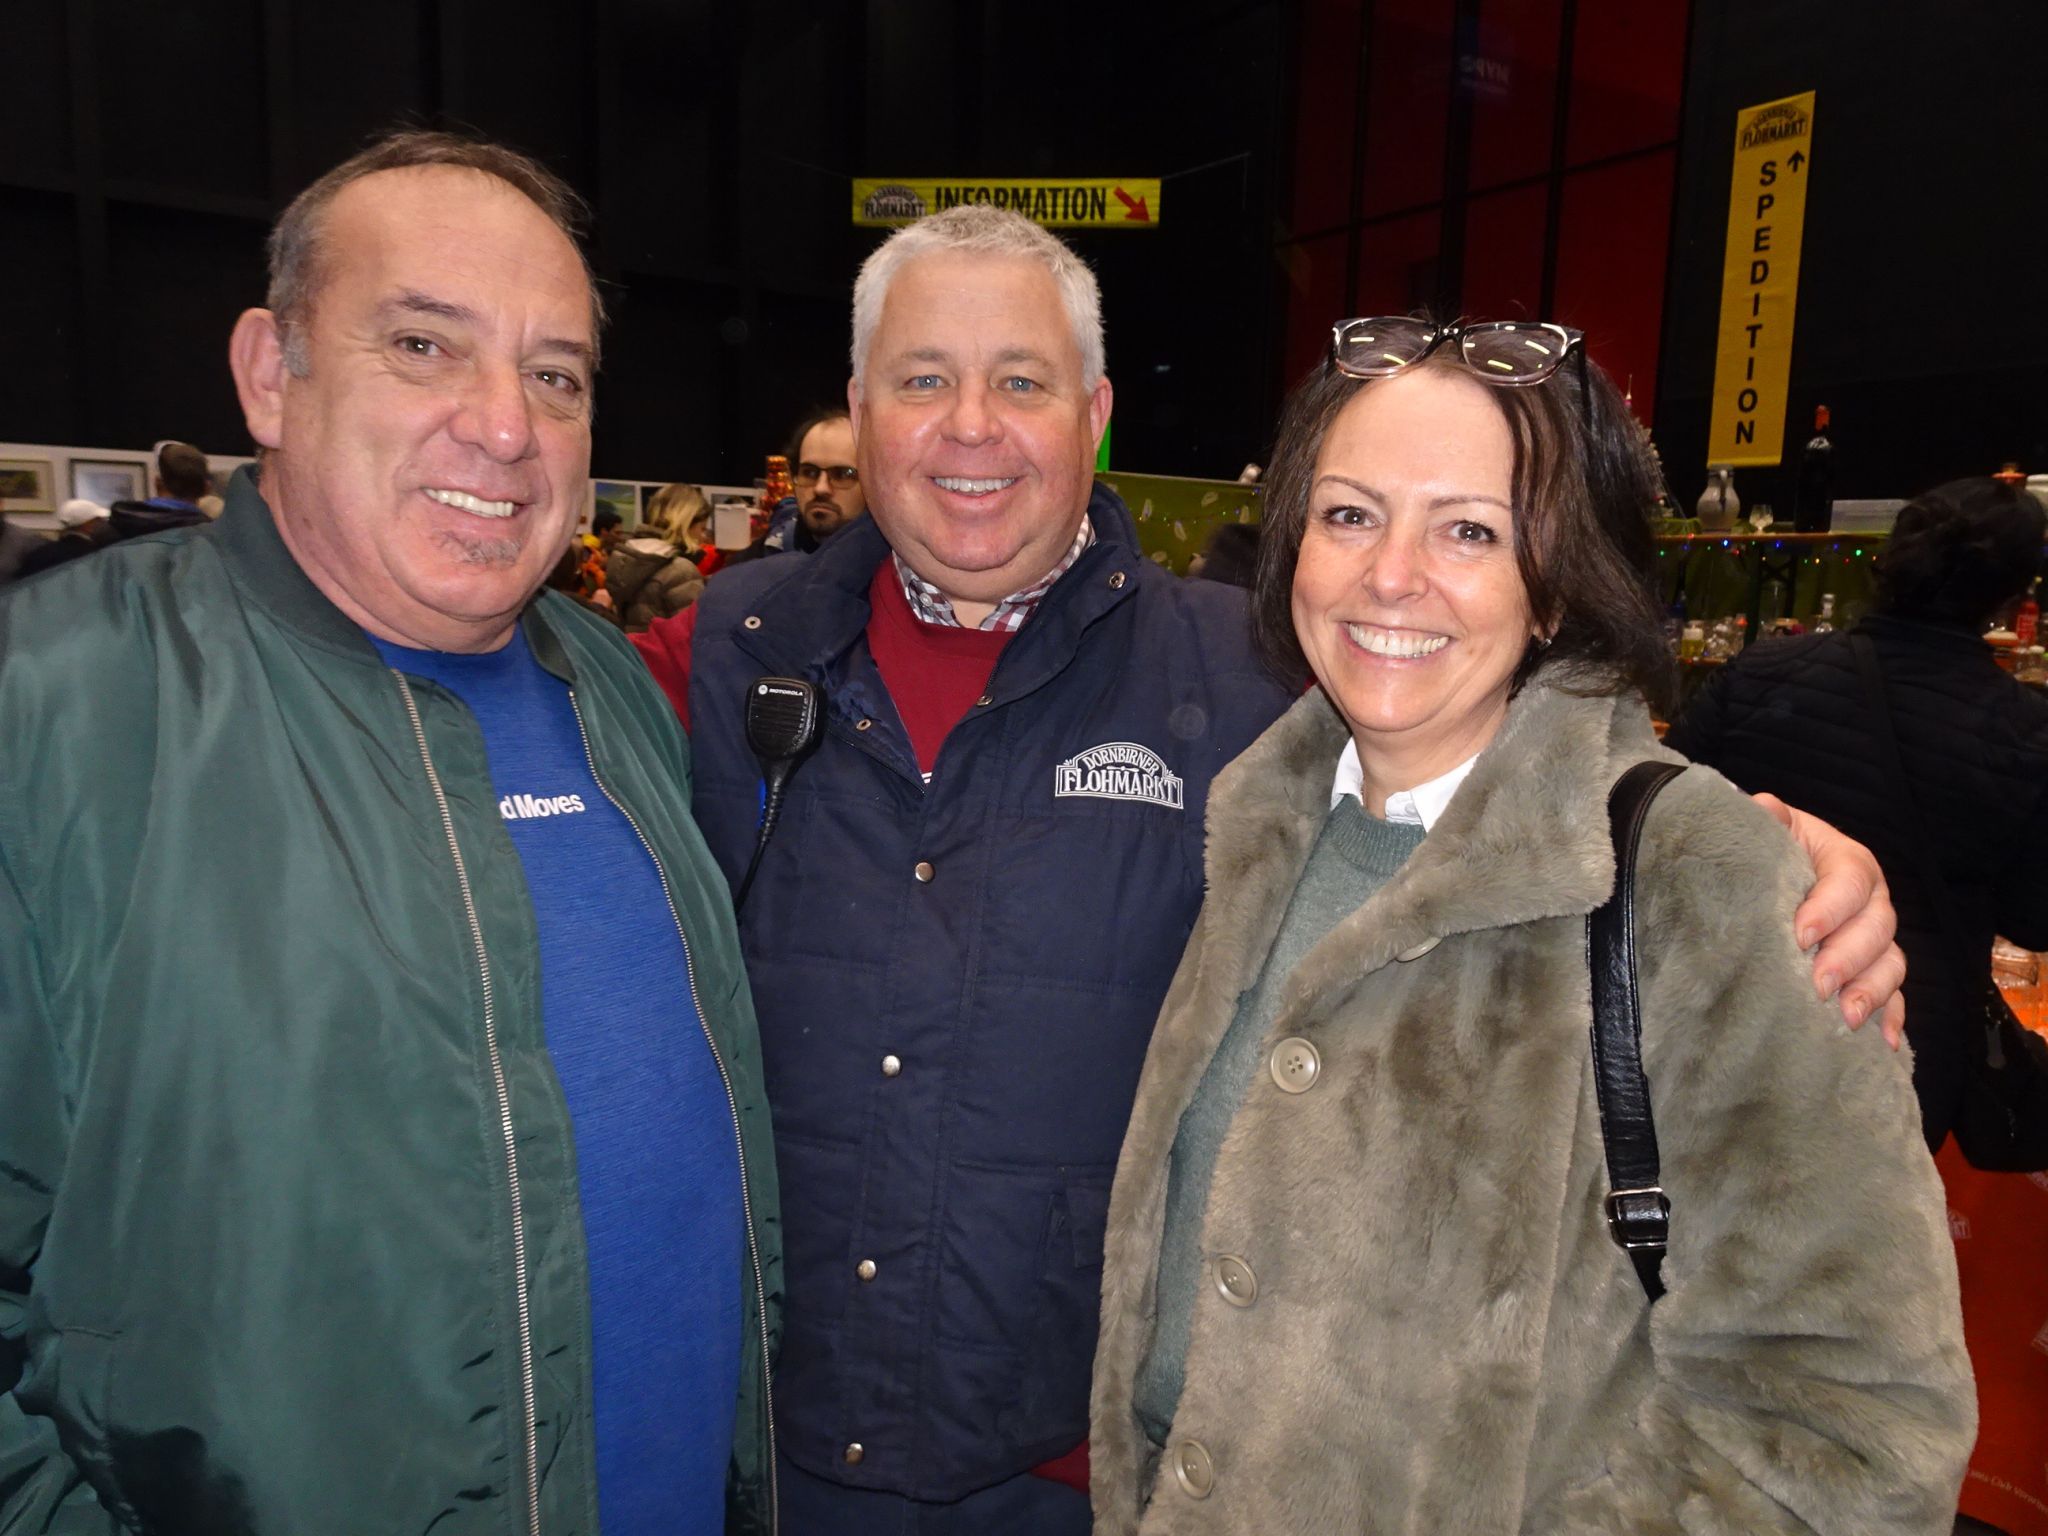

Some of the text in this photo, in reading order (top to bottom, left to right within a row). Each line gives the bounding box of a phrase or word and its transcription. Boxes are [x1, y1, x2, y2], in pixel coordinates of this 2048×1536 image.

[1740, 118, 1806, 150] FLOHMARKT
[864, 201, 927, 218] FLOHMARKT
[935, 186, 1106, 220] INFORMATION
[1735, 161, 1776, 444] SPEDITION
[769, 688, 803, 696] MOTOROLA
[1083, 747, 1160, 776] DORNBIRNER
[1063, 768, 1177, 803] FLOHMARKT
[513, 793, 586, 818] Moves
